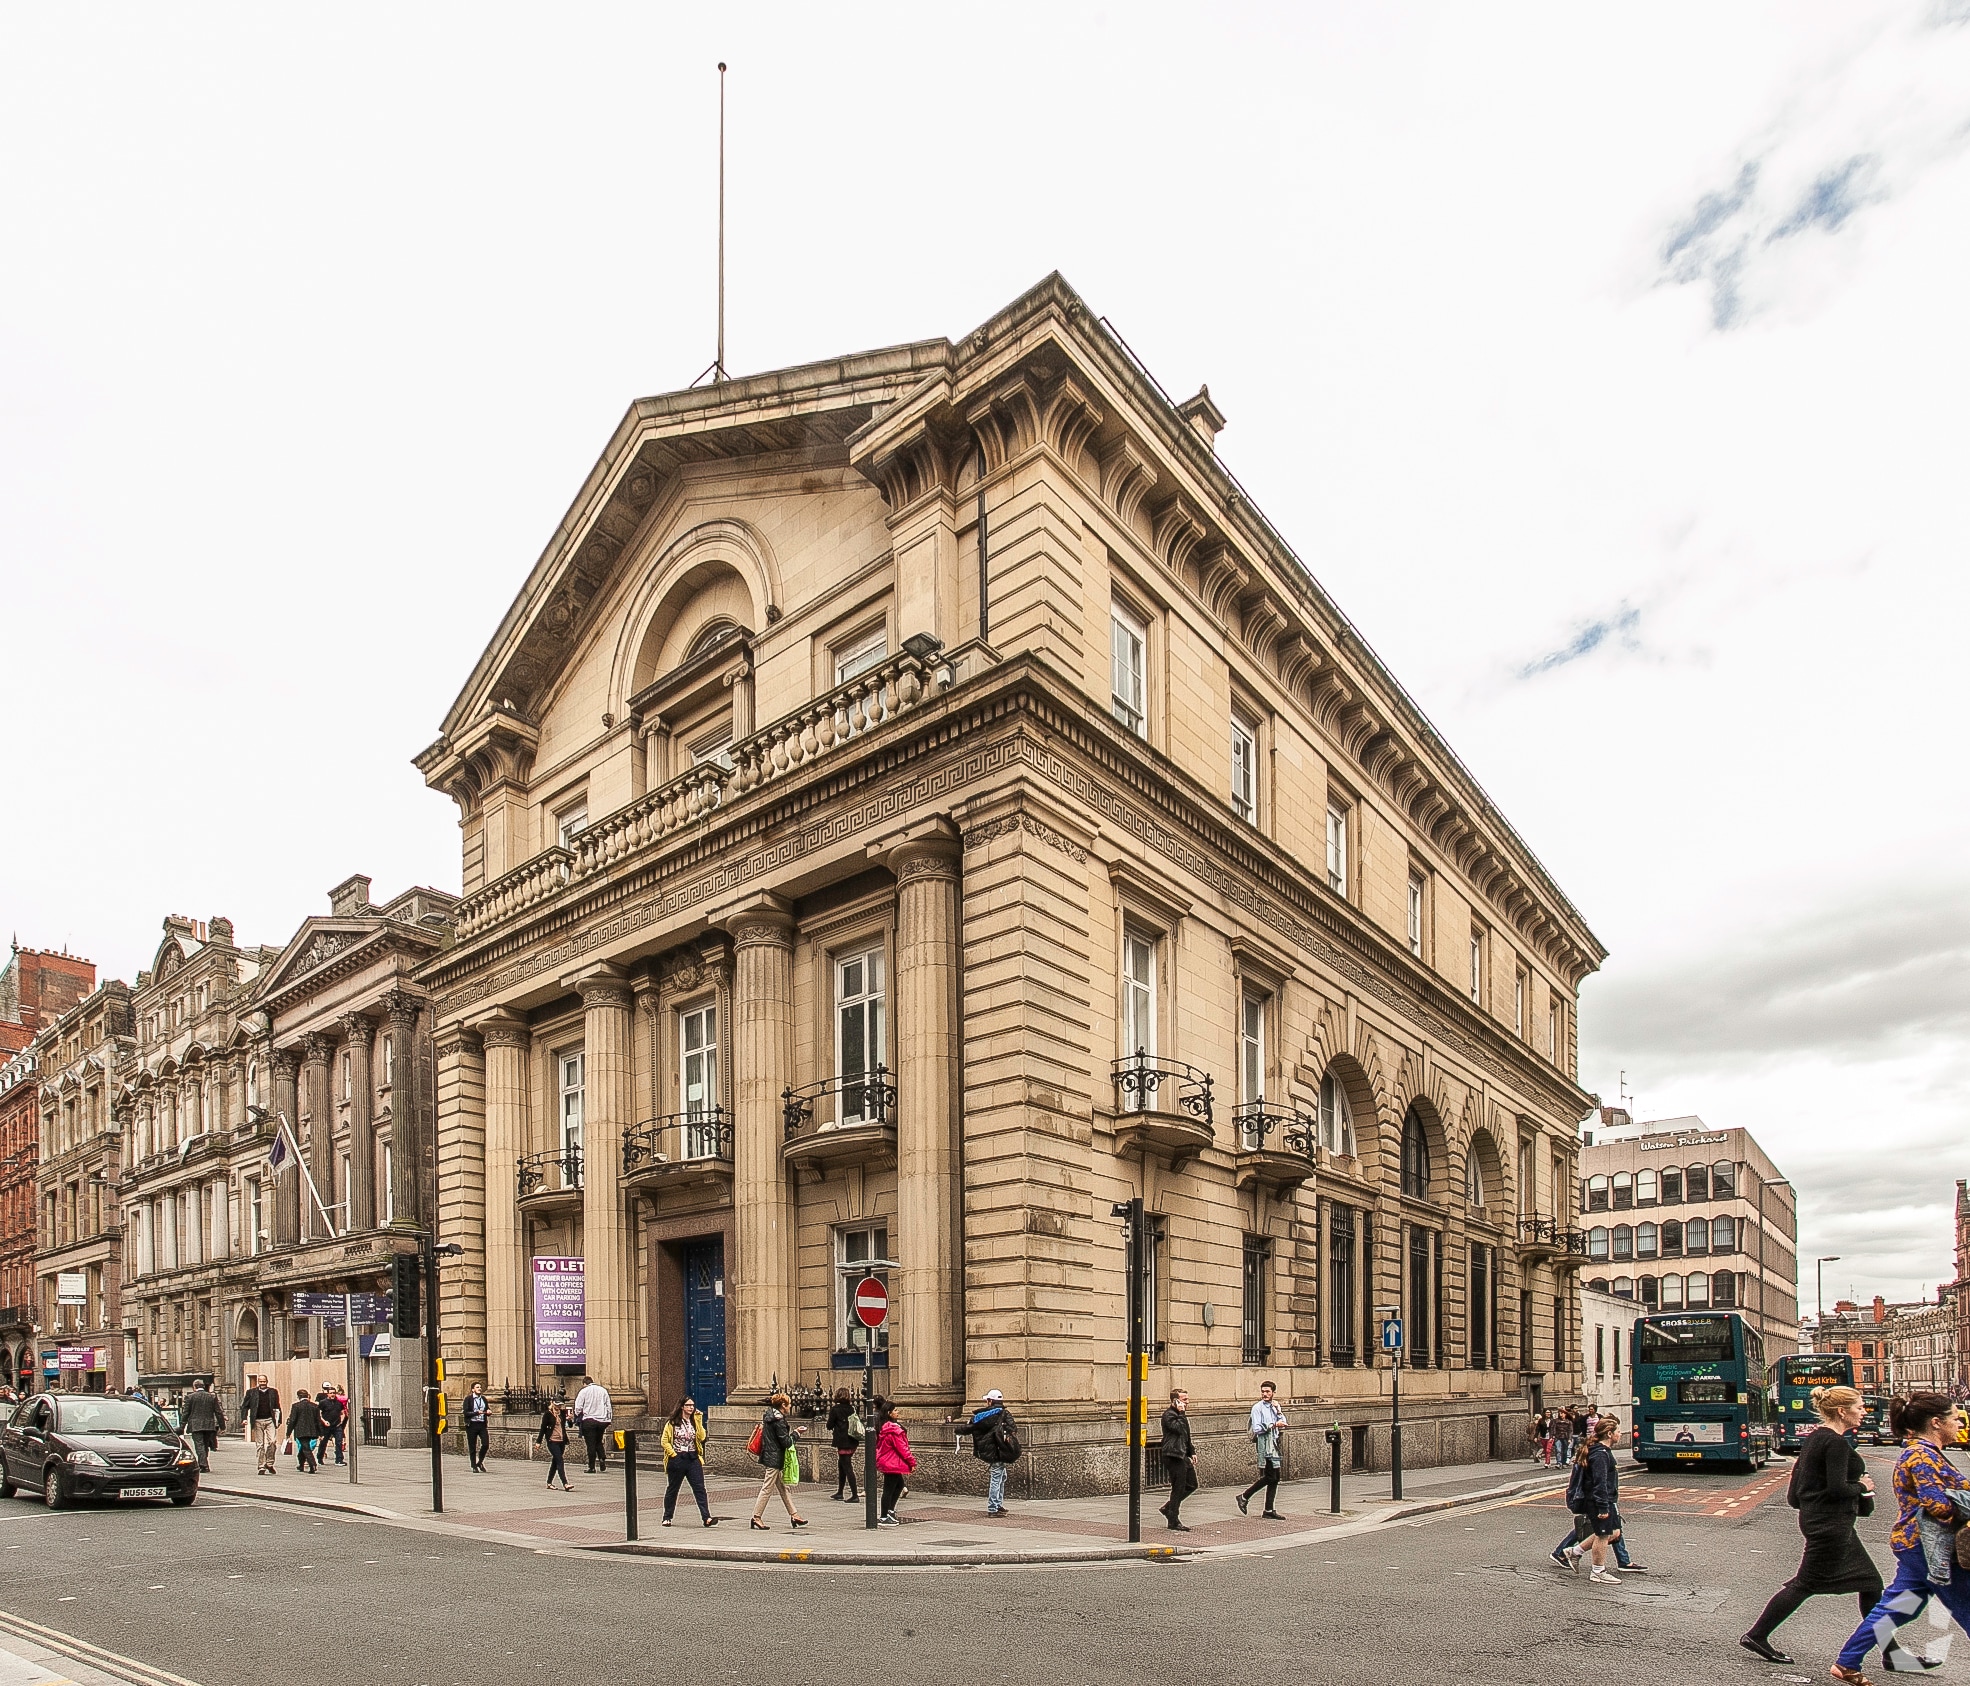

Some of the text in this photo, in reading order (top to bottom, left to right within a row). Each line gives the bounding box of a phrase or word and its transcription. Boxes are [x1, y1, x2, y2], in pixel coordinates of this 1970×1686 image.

[1640, 1133, 1728, 1151] Watson Prickard
[537, 1260, 585, 1271] TO LET
[539, 1330, 578, 1338] mason
